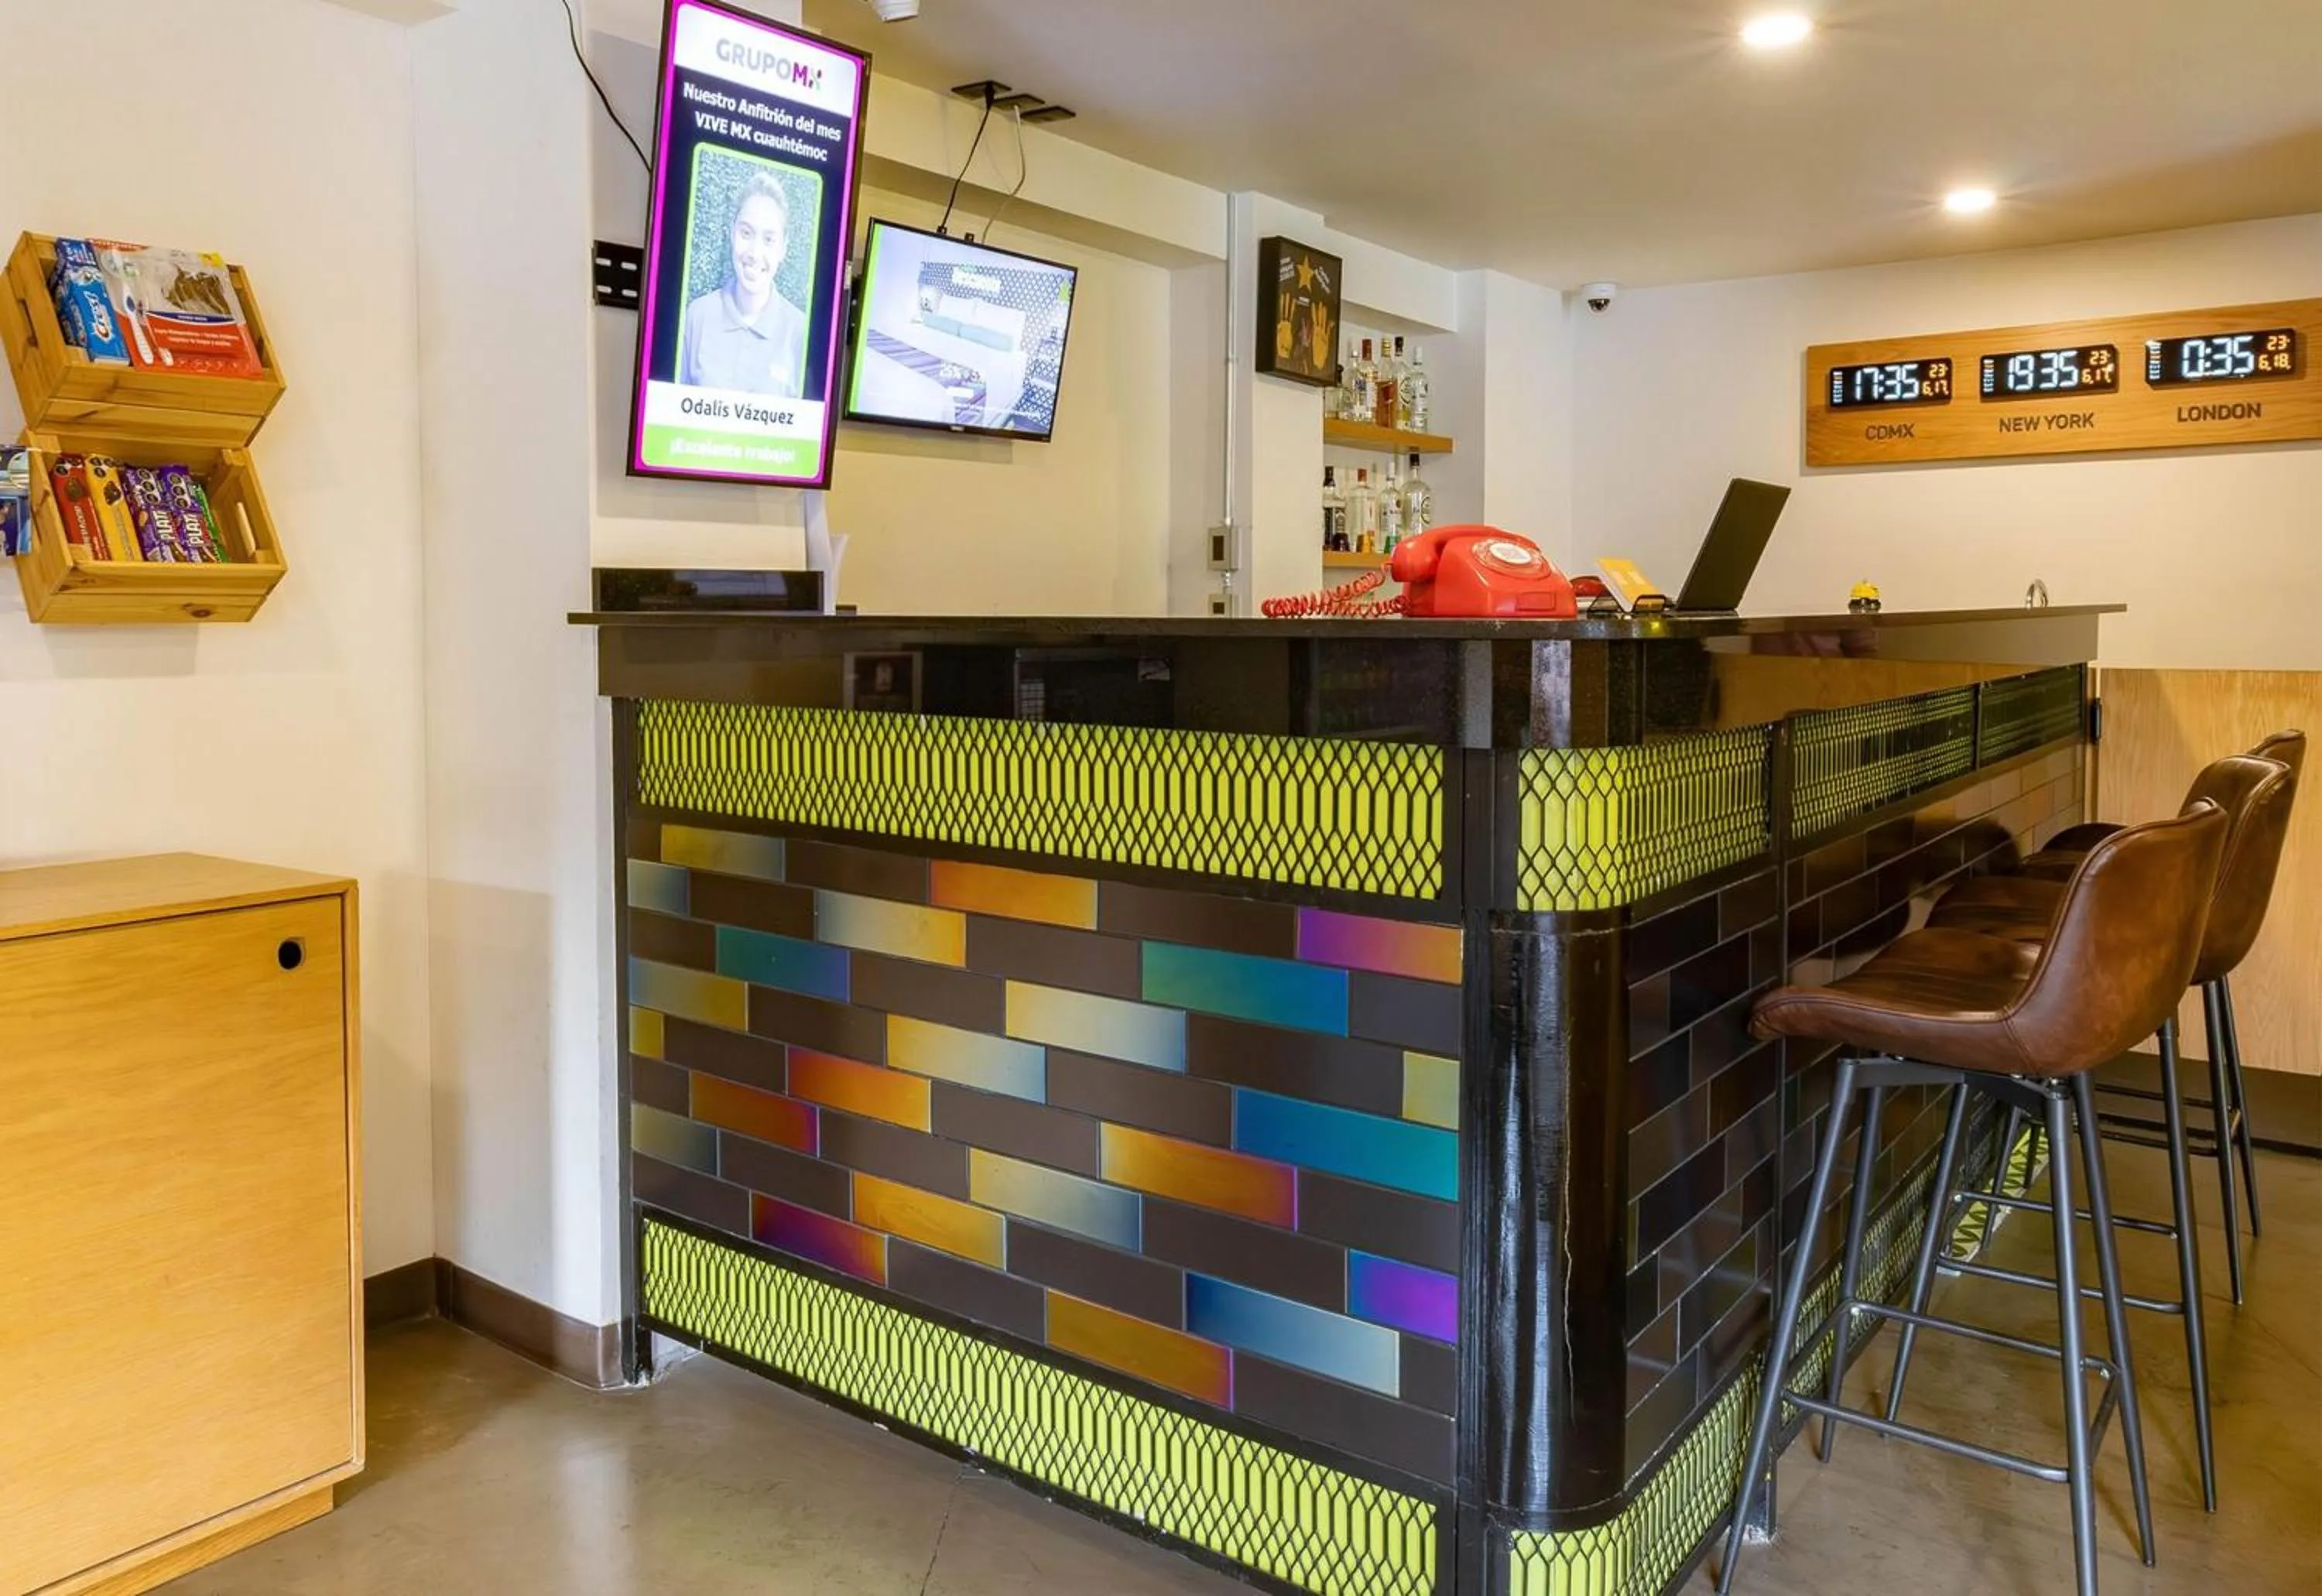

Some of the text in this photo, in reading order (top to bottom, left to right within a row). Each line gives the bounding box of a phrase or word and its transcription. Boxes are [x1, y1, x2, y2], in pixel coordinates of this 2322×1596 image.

[683, 81, 841, 142] Nuestro Anfitrión del mes
[694, 111, 827, 162] VIVE MX cuauhtémoc
[1855, 363, 1920, 401] 17:35
[734, 402, 794, 426] Vázquez
[1998, 412, 2094, 433] NEW YORK
[2176, 402, 2262, 423] LONDON
[1865, 423, 1916, 440] CDMX
